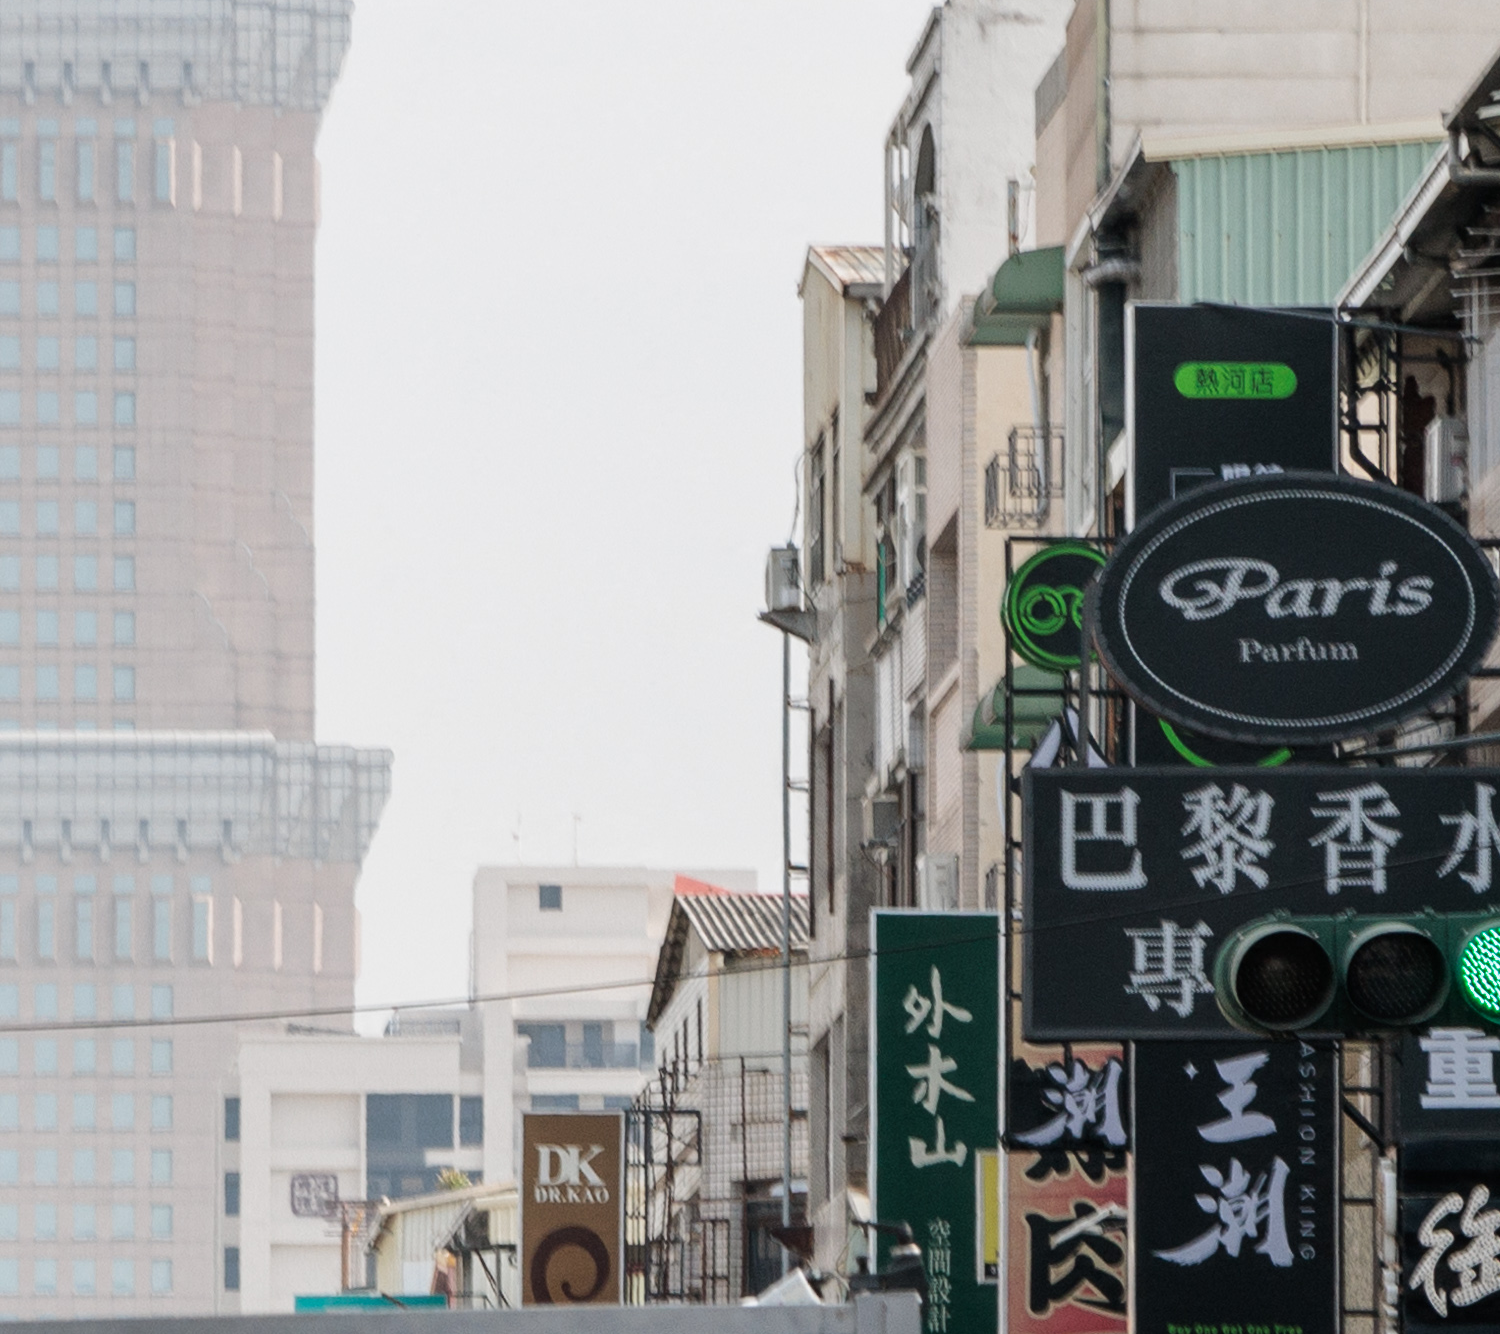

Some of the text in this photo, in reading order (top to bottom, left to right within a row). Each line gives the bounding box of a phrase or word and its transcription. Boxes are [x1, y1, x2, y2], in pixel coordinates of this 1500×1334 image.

[1195, 369, 1274, 397] 熱河店
[1159, 558, 1434, 621] Paris
[1237, 636, 1359, 664] Parfum
[1297, 1042, 1316, 1165] ASHION
[534, 1143, 605, 1185] DK
